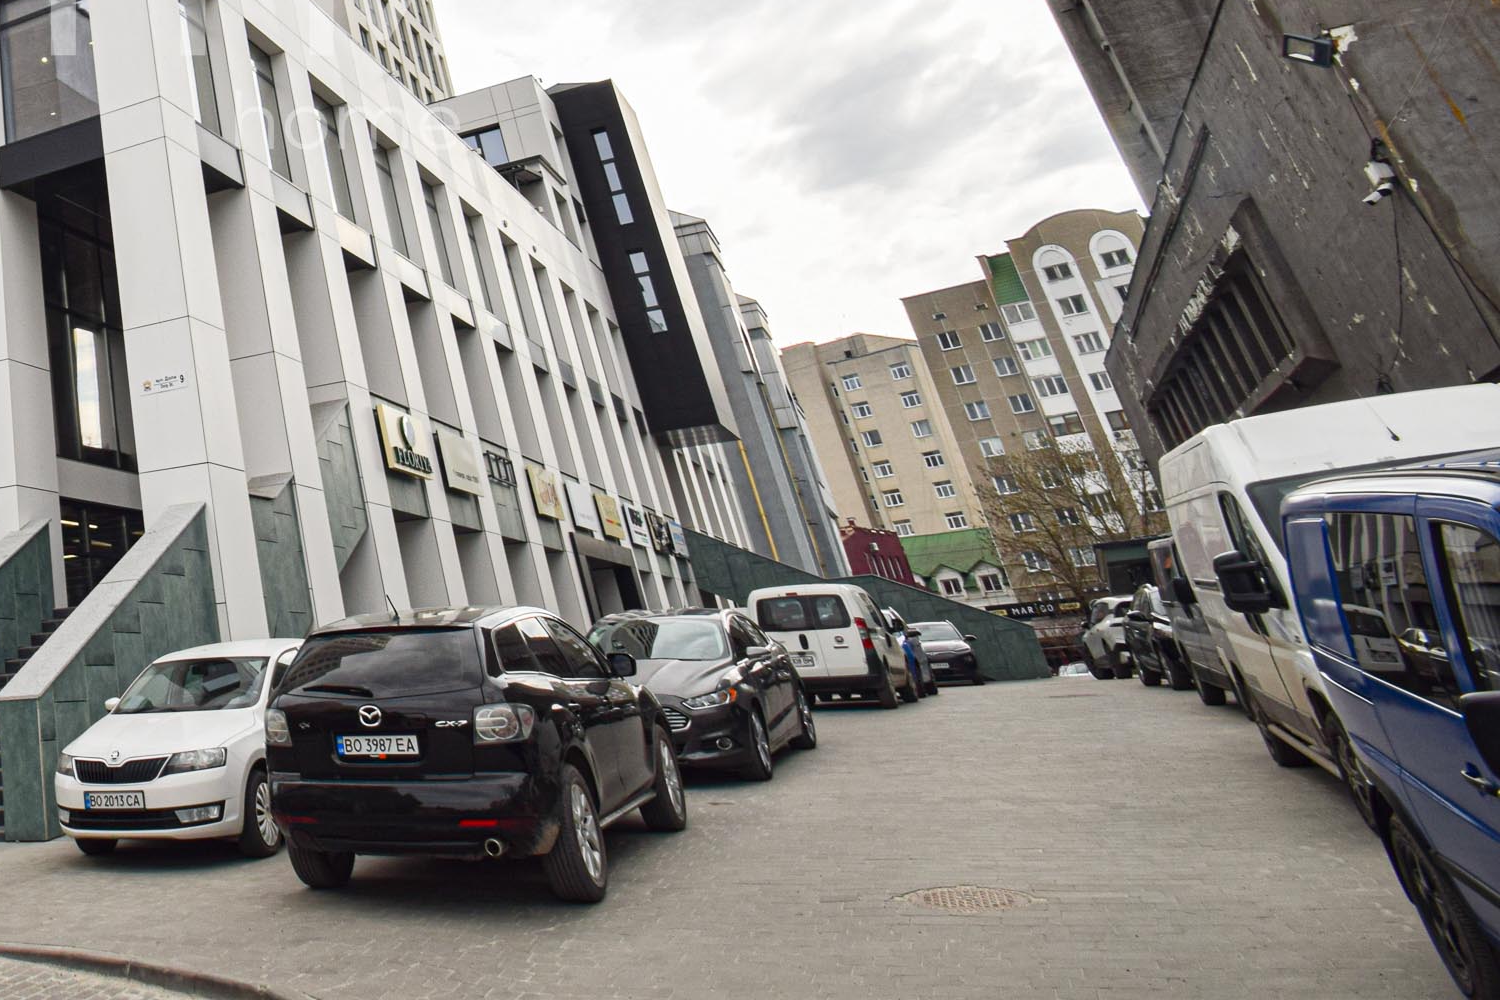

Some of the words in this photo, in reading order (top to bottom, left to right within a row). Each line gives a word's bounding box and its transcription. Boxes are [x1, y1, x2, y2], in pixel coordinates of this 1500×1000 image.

[394, 446, 433, 474] FLORIYA
[435, 719, 468, 727] CX-7
[344, 738, 362, 752] BO
[366, 738, 392, 753] 3987
[396, 738, 415, 752] EA
[90, 795, 102, 807] BO
[104, 795, 124, 807] 2013
[126, 794, 140, 806] CA
